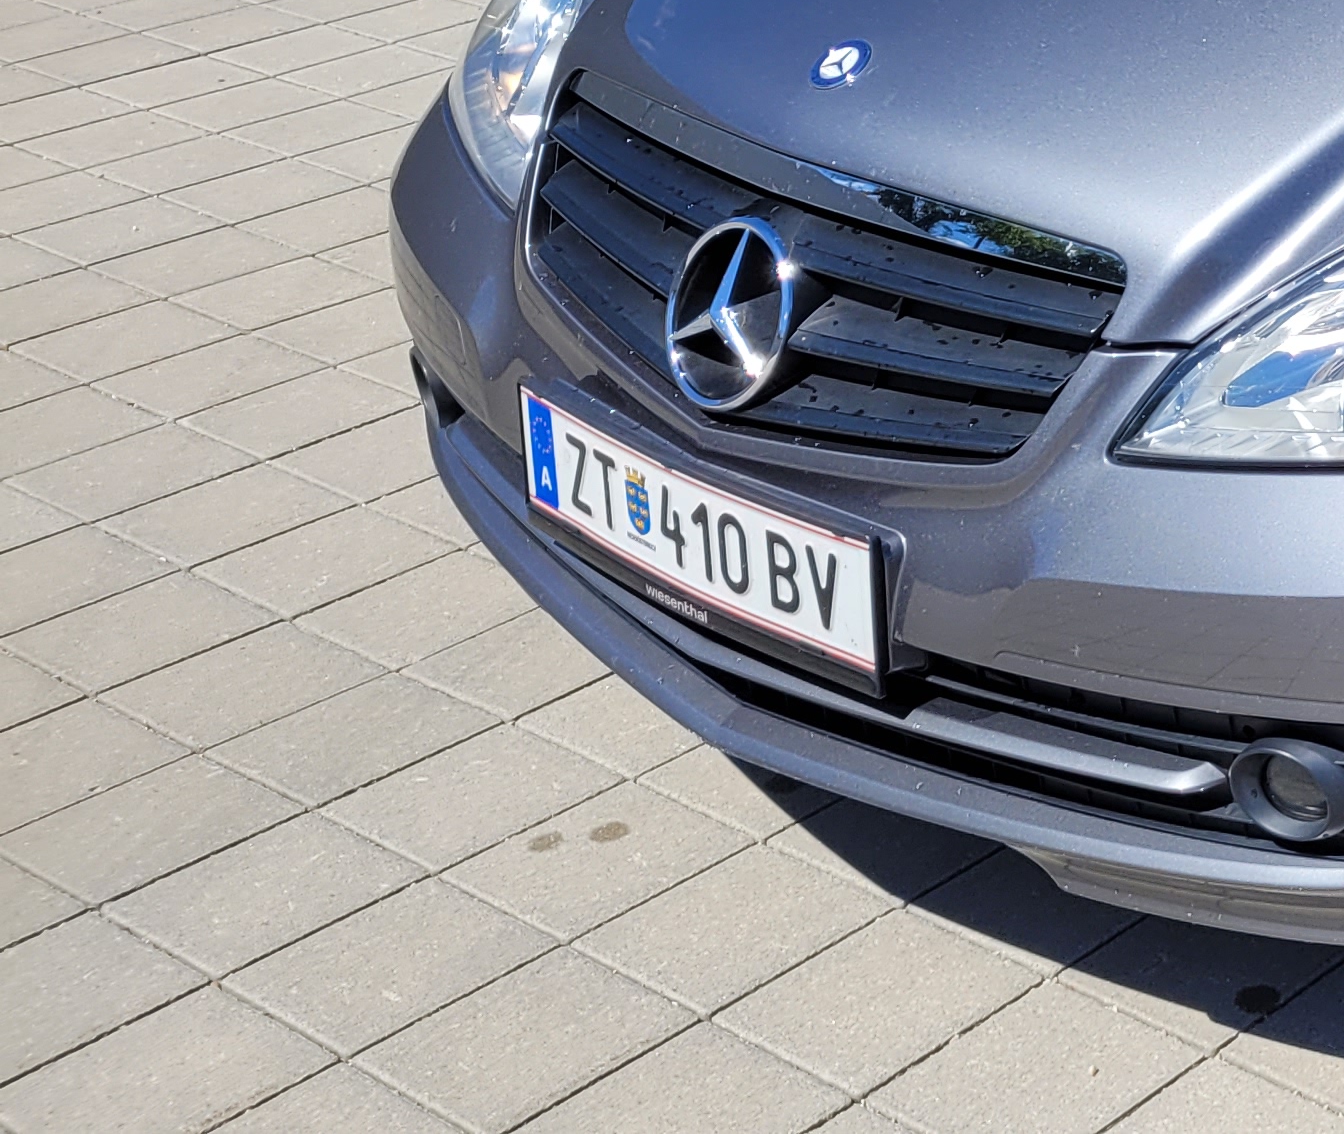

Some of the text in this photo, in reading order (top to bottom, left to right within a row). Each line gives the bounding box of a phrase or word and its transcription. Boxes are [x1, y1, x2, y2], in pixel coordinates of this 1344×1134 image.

[541, 465, 553, 492] A
[565, 432, 837, 631] ZT 410 BV
[645, 583, 709, 624] wiesenthal
